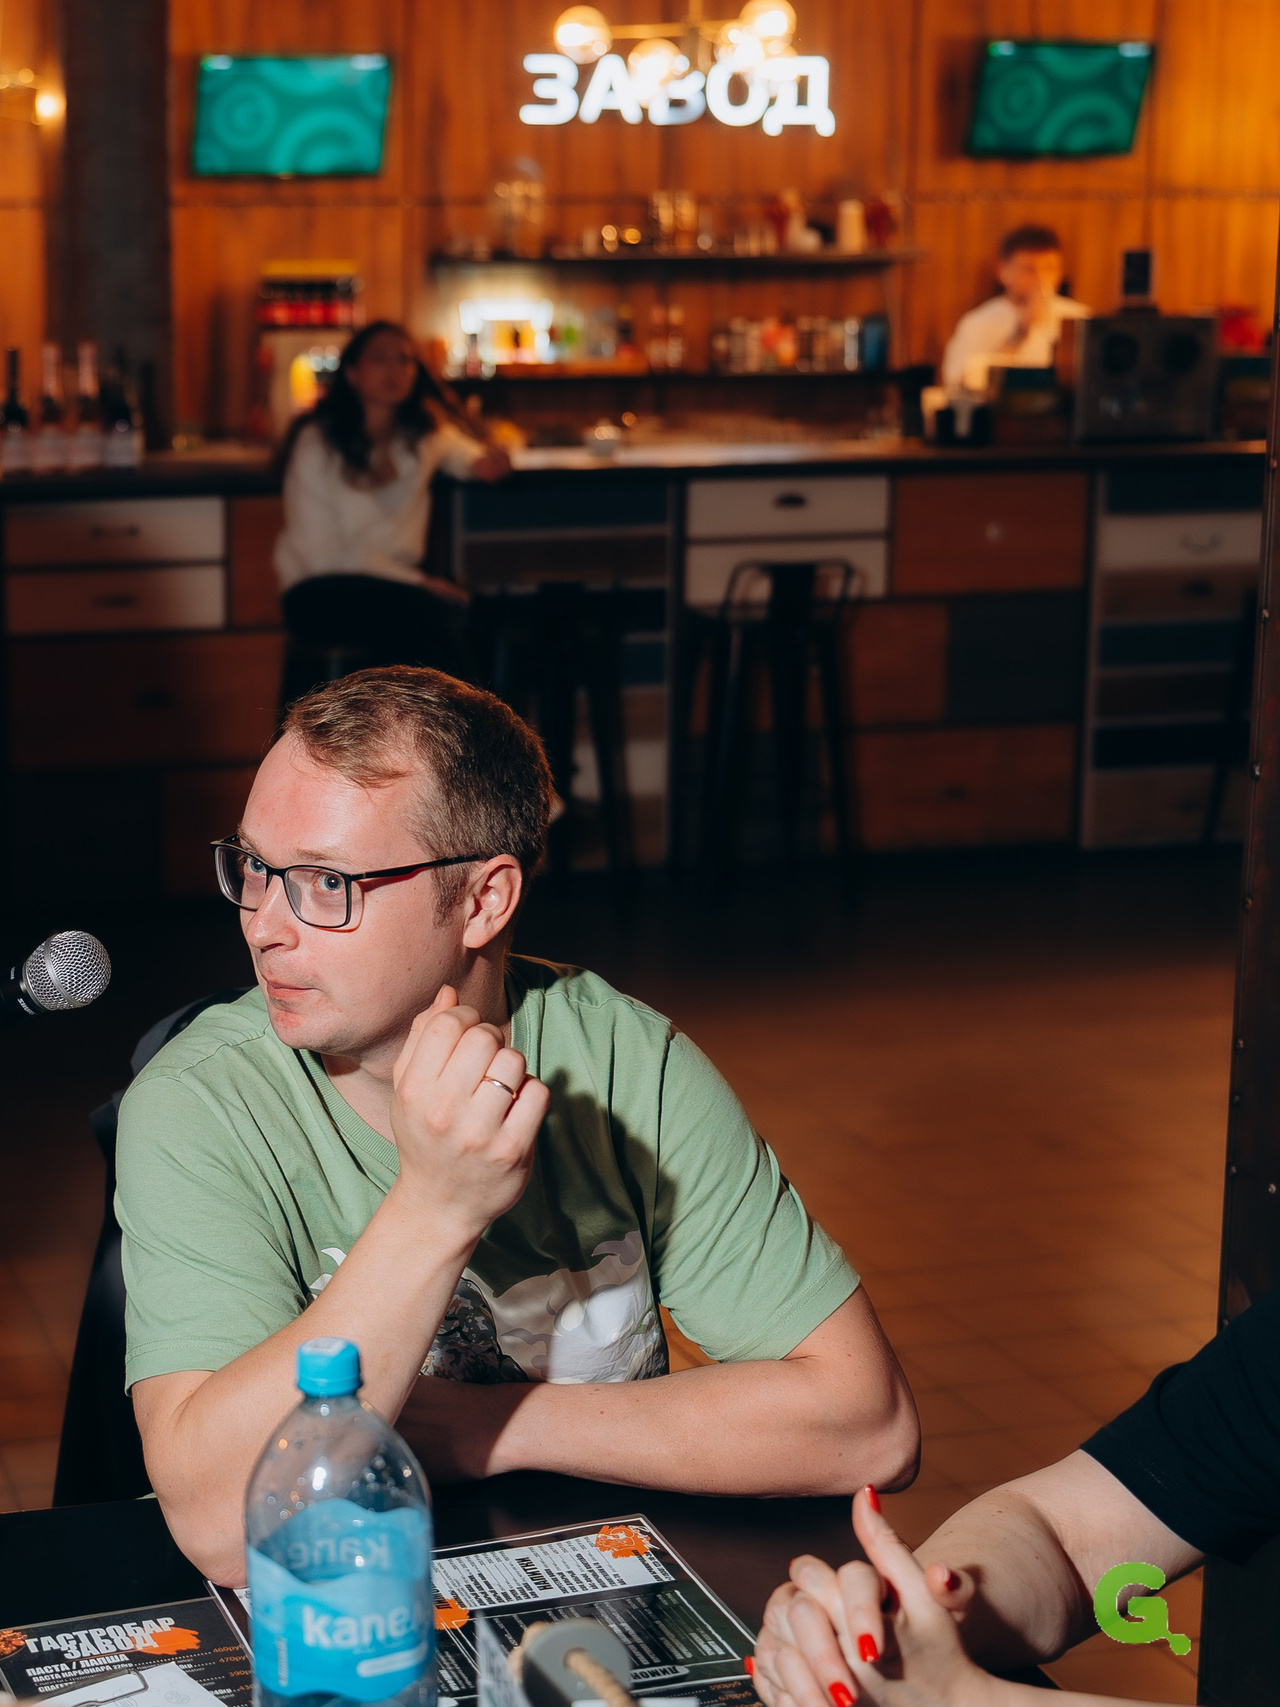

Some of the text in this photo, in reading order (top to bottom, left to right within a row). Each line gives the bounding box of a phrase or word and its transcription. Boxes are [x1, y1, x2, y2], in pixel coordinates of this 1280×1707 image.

[519, 53, 836, 137] ЗАВОД
[514, 1556, 553, 1590] НАПИТКИ
[25, 1617, 175, 1653] ГАСТРОБАР
[63, 1630, 158, 1659] ЗАВОД
[26, 1662, 70, 1677] ПАСТА
[80, 1654, 129, 1668] ЛАПША
[32, 1673, 61, 1682] ПАСТА
[61, 1665, 112, 1678] КАРБОНАРА
[630, 1666, 680, 1680] ЛИМОН
